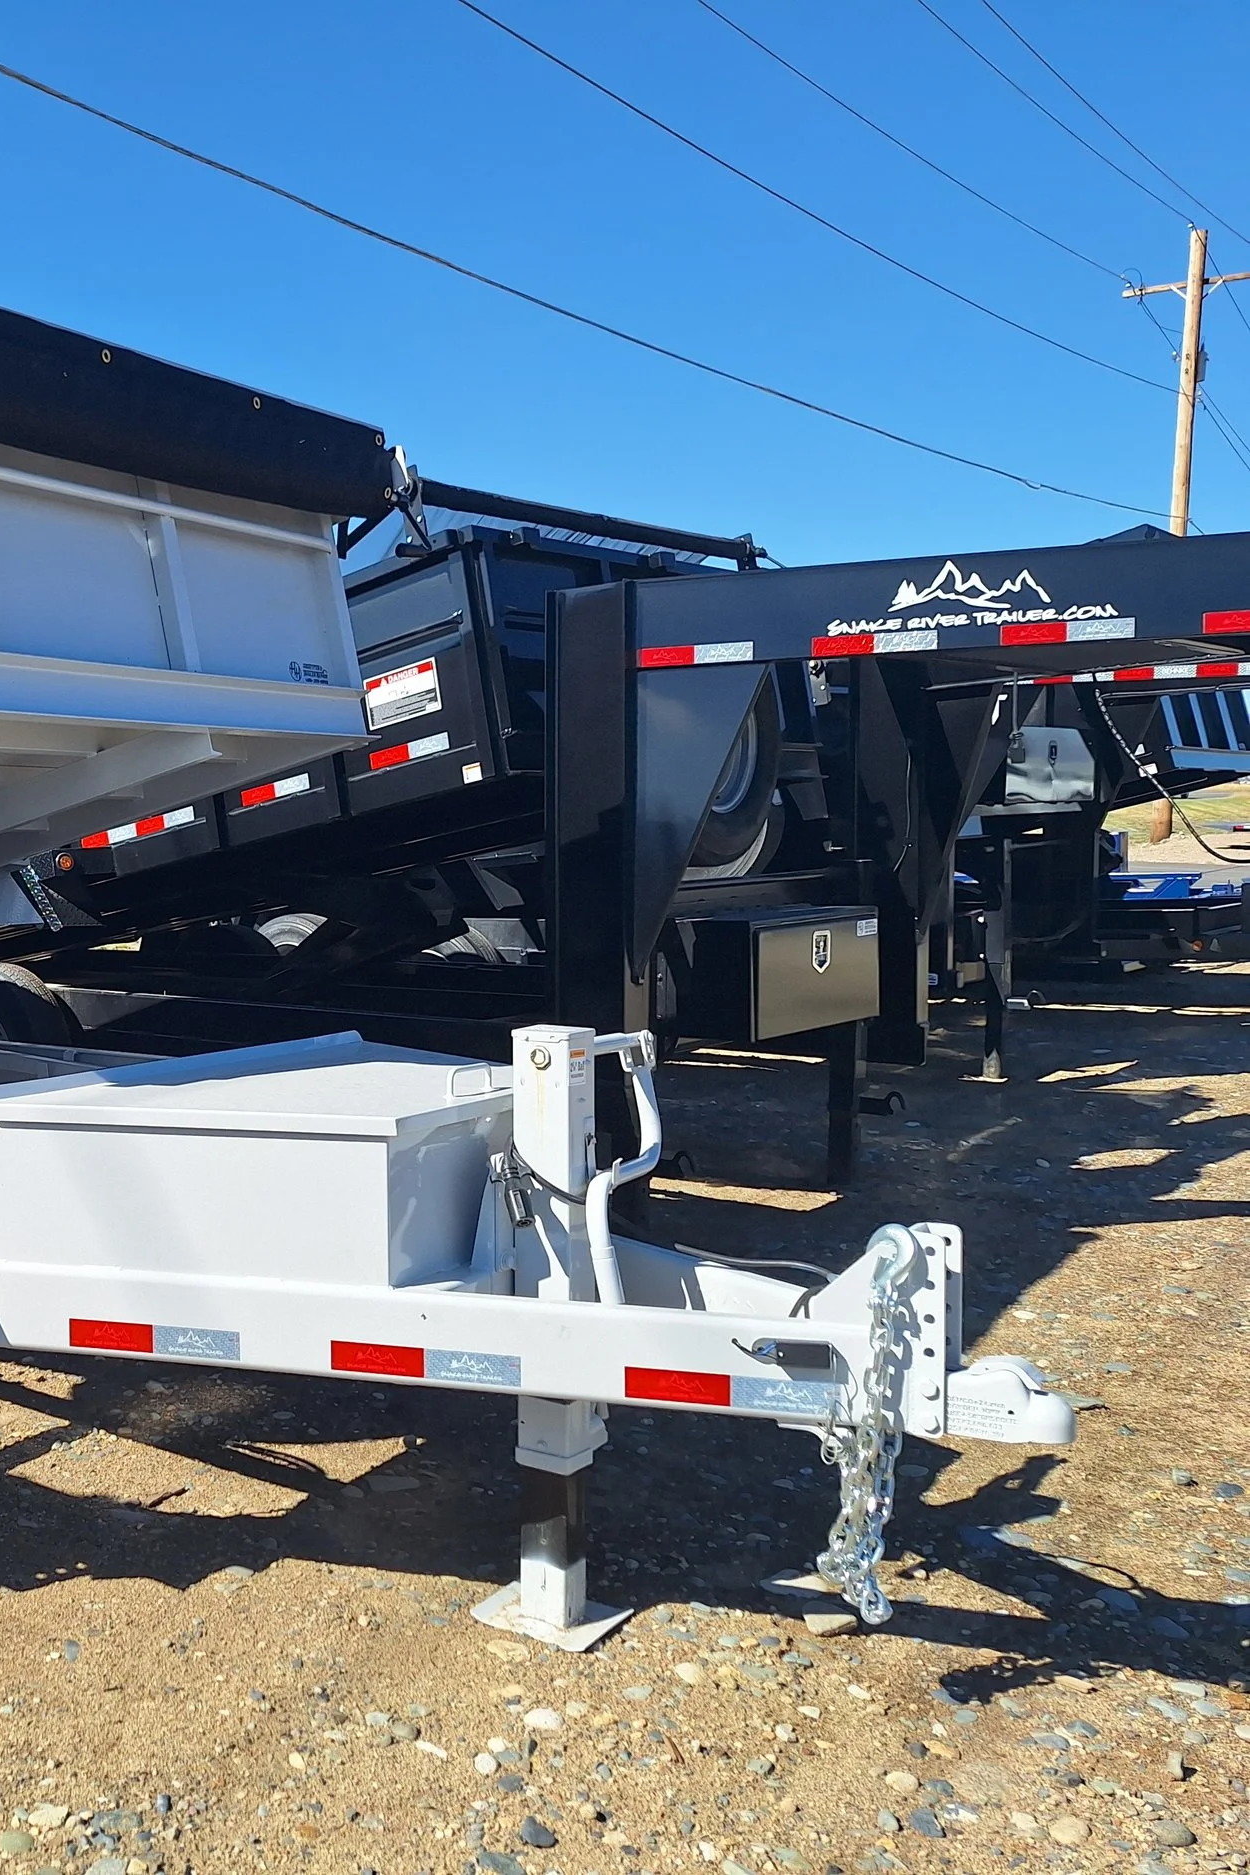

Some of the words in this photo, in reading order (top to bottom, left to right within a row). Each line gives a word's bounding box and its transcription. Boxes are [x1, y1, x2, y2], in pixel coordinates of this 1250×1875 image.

[826, 619, 903, 637] SNAKE
[907, 613, 971, 630] RIVER
[972, 603, 1119, 626] TRAILER.COM
[387, 667, 419, 684] DANGER
